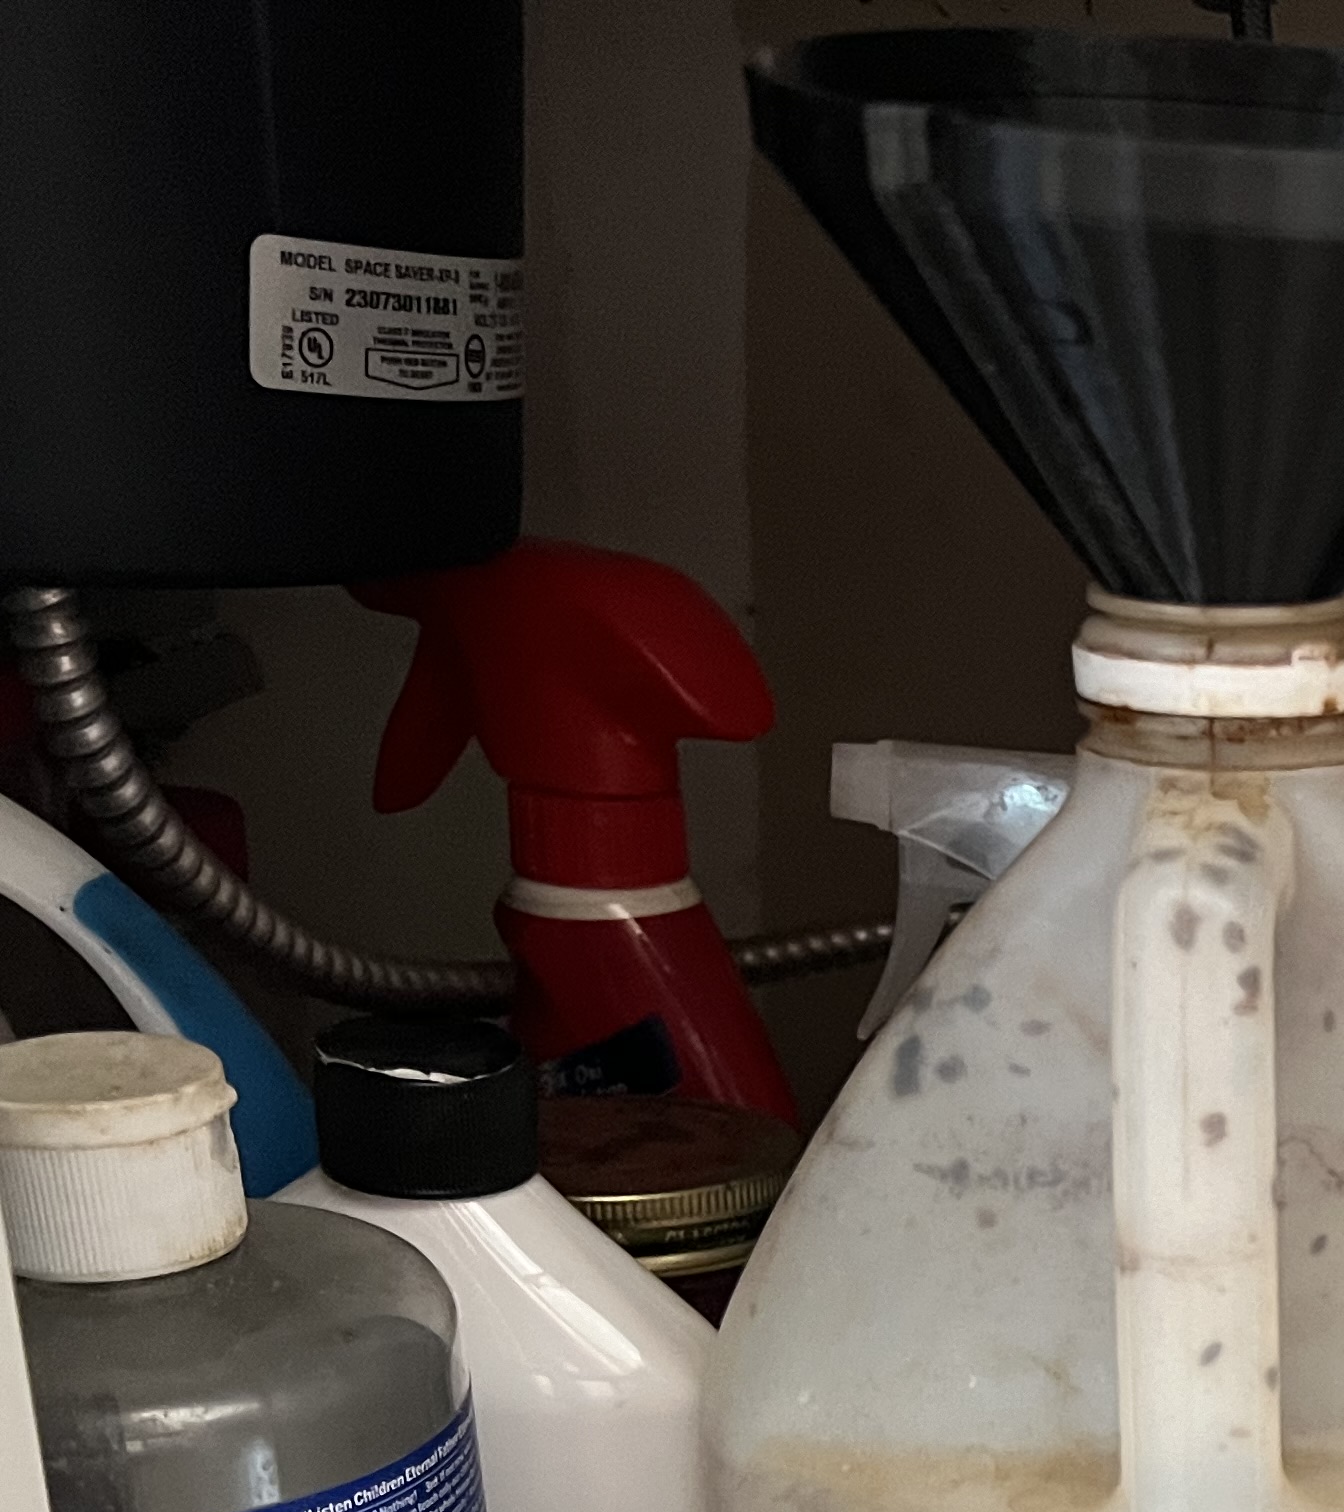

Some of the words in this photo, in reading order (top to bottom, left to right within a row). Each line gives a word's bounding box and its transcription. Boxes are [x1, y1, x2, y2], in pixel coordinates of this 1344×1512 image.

[280, 250, 337, 272] MODEL
[345, 258, 391, 278] SPACE
[308, 286, 334, 303] S/N
[291, 308, 339, 326] LISTED
[354, 1475, 404, 1506] Children
[405, 1452, 439, 1481] Eternal
